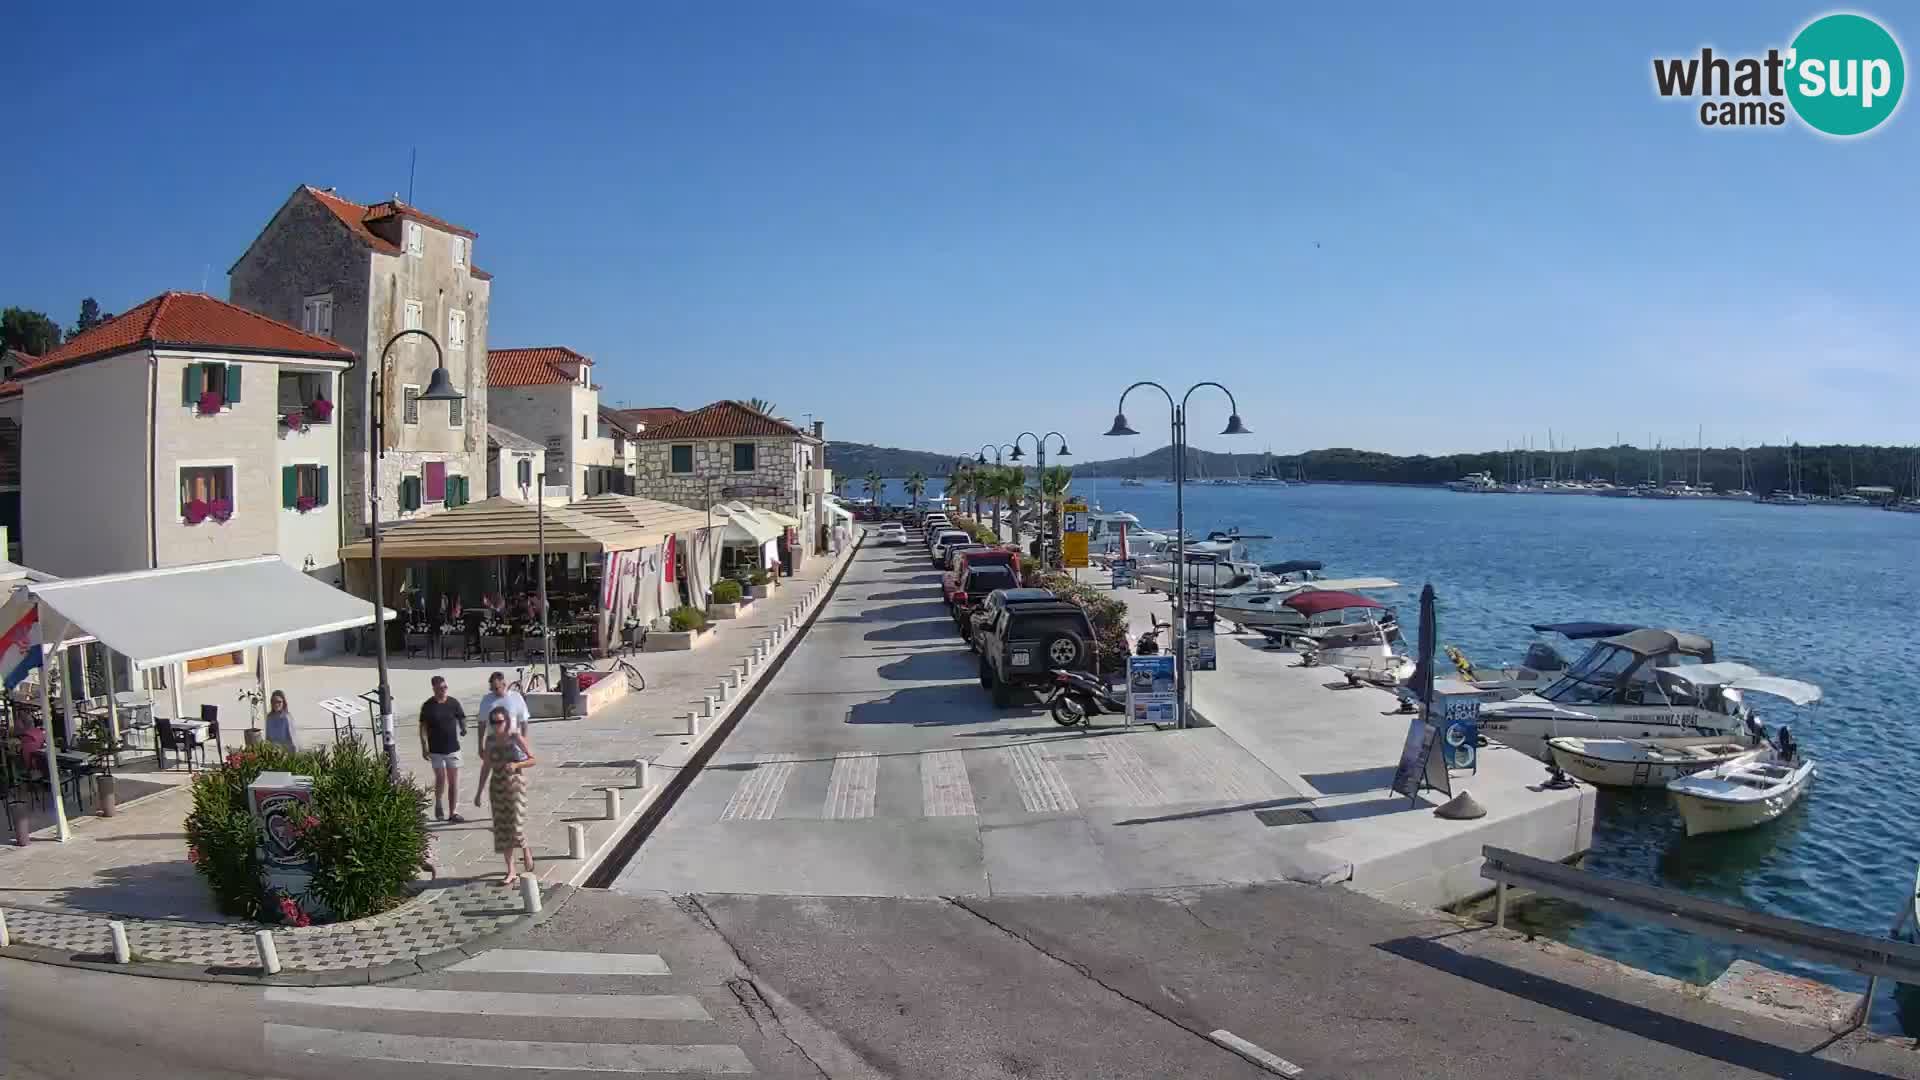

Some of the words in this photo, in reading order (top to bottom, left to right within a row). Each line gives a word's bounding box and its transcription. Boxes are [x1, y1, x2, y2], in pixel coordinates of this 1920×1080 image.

[1065, 514, 1076, 530] P
[1447, 703, 1478, 712] RENT
[1446, 711, 1453, 720] A
[1455, 711, 1477, 720] BOAT
